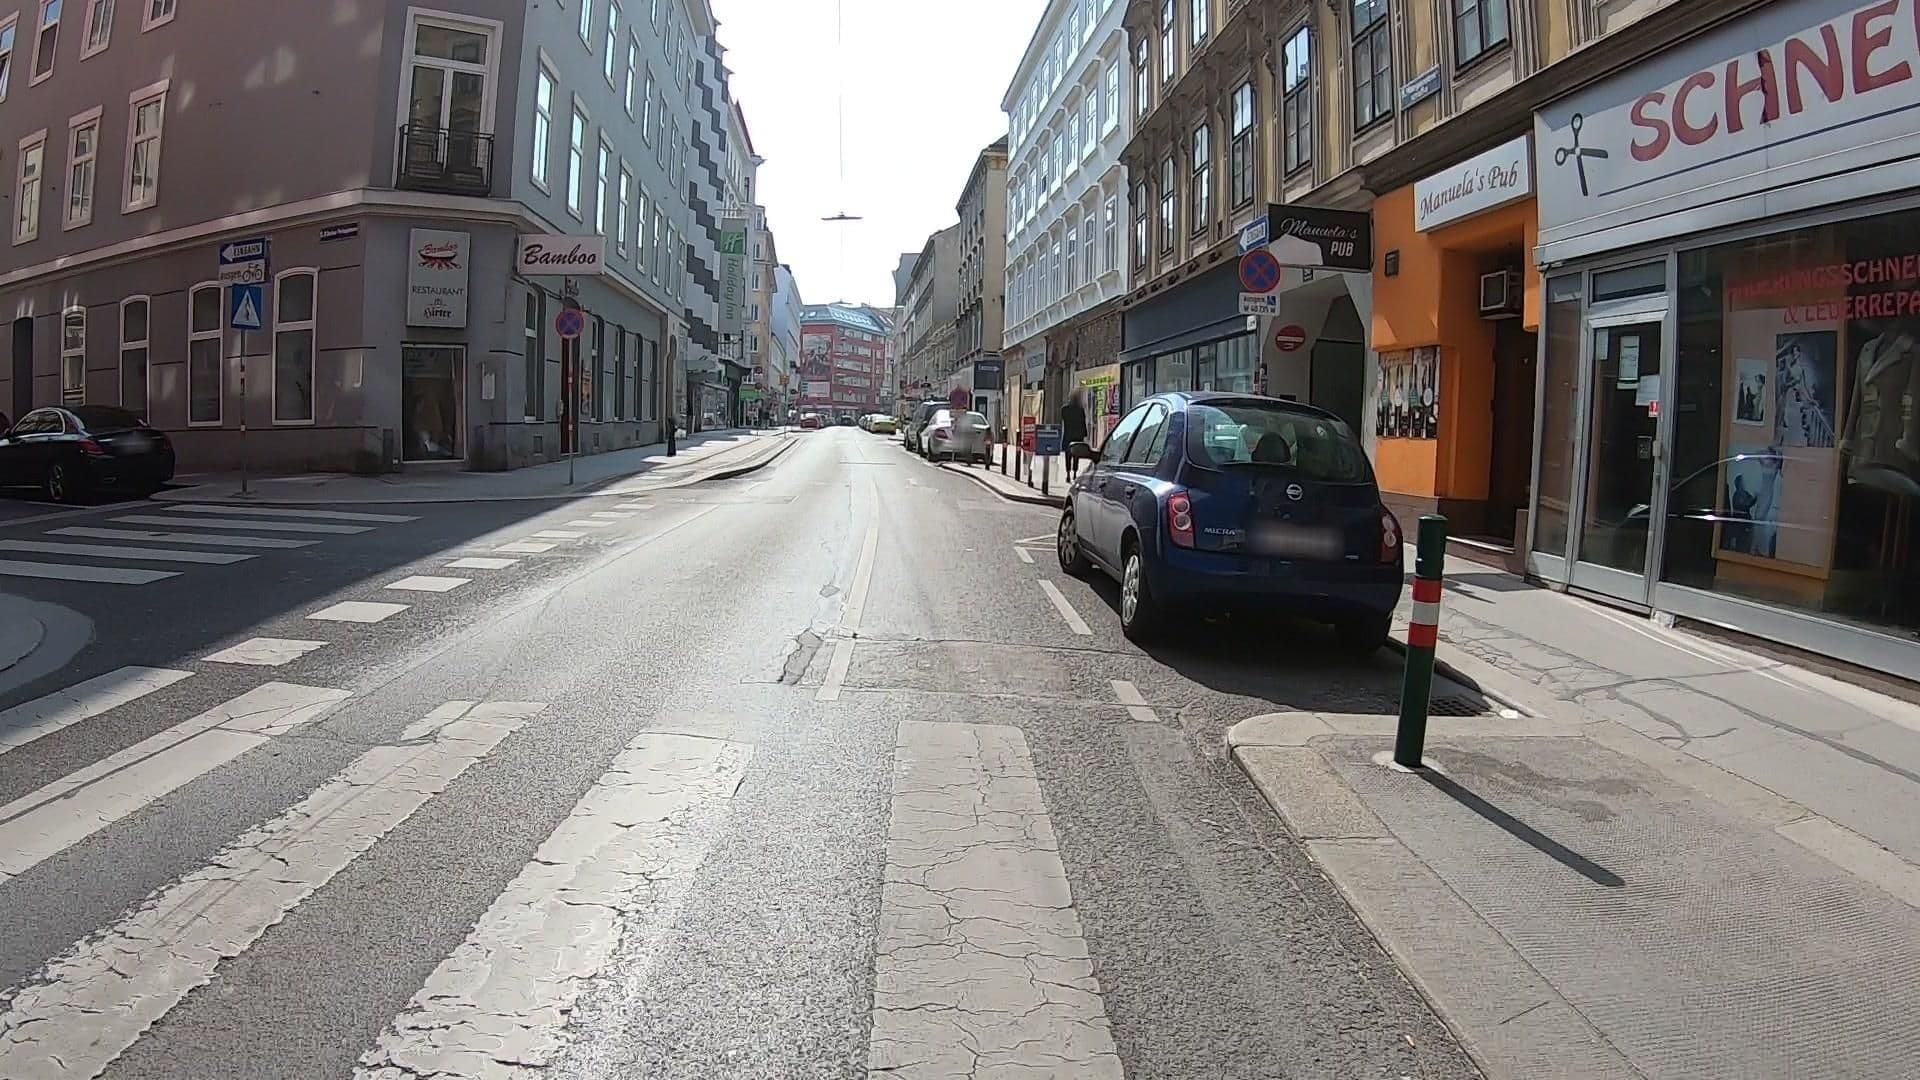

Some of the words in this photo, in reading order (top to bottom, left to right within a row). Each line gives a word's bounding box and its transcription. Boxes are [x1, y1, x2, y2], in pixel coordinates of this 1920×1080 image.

[1421, 168, 1485, 220] Manuela's
[1488, 160, 1518, 189] Pub
[524, 243, 597, 265] Bamboo
[1330, 241, 1354, 256] PUB
[725, 258, 739, 300] Holiday
[412, 285, 464, 296] RESTAURANT
[726, 302, 738, 320] Inn
[1204, 527, 1236, 536] MICRA
